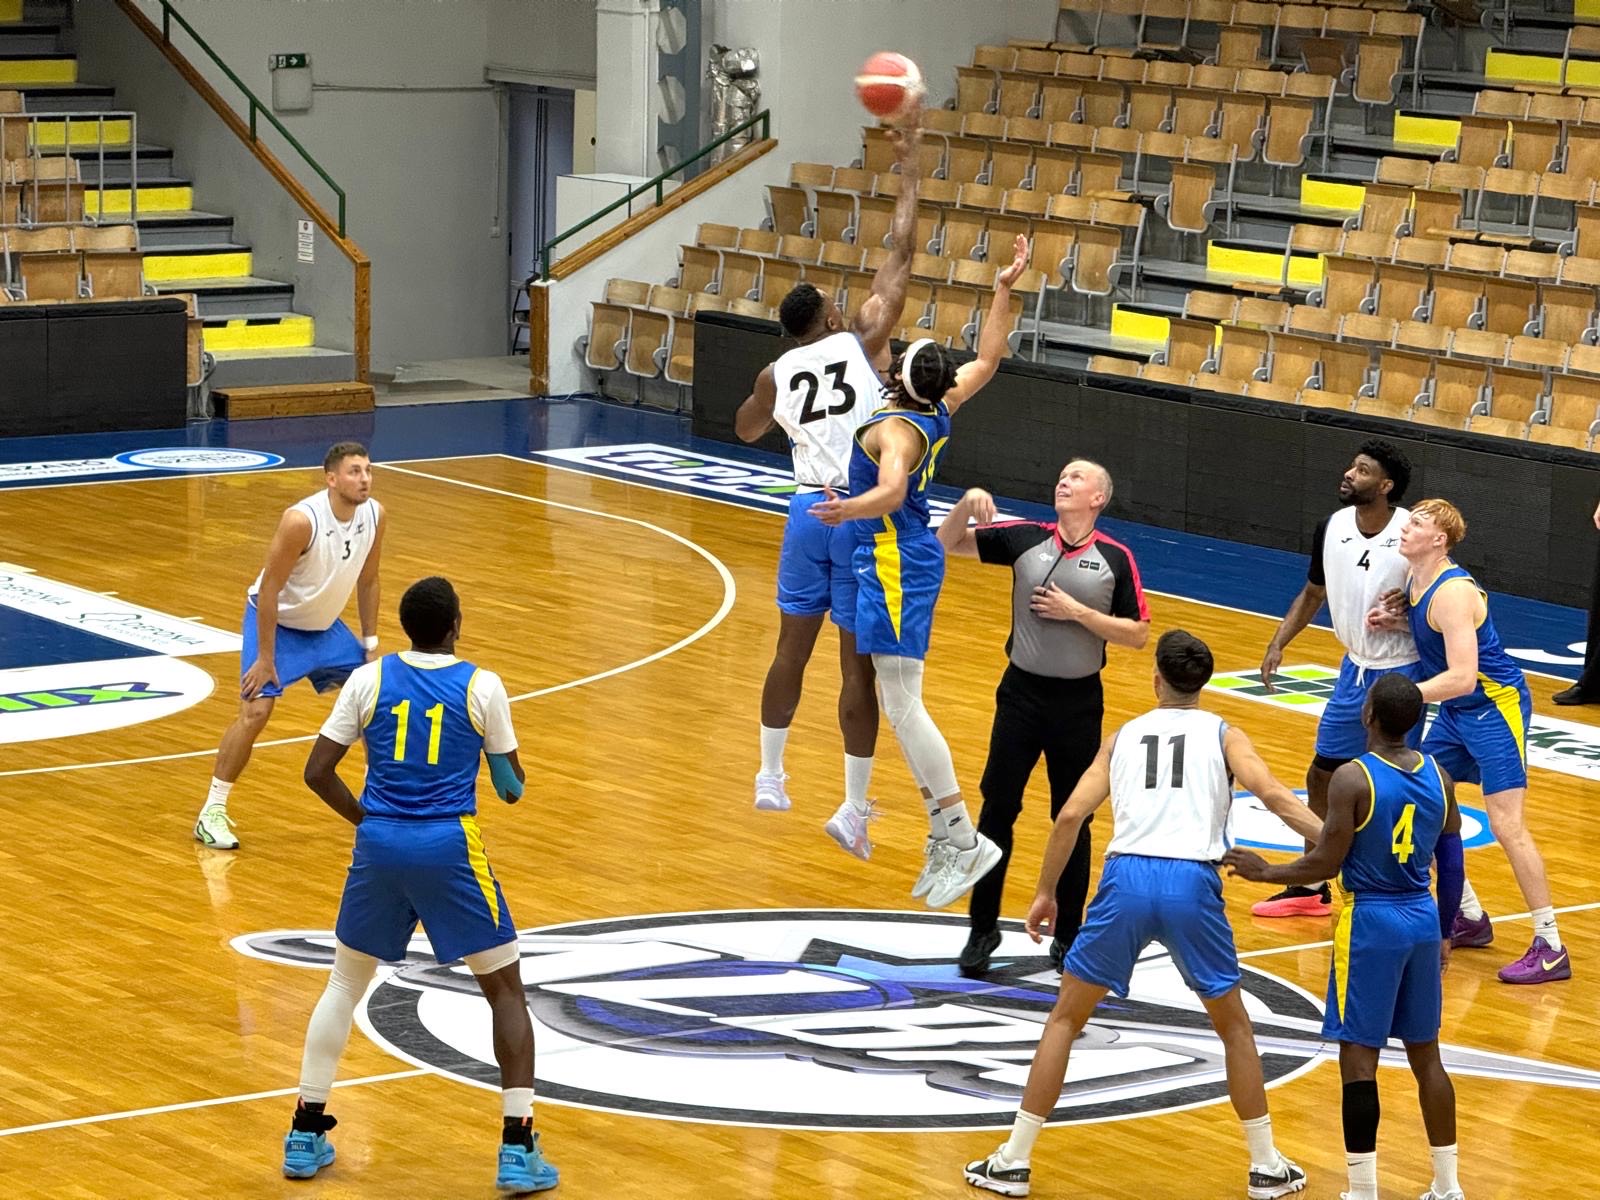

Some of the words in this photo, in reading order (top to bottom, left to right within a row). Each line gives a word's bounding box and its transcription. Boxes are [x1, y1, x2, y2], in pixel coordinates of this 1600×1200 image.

[788, 360, 857, 425] 23
[587, 450, 798, 499] TiPP
[342, 540, 351, 560] 3
[1356, 550, 1370, 571] 4
[391, 699, 444, 765] 11
[1139, 734, 1186, 789] 11
[1391, 803, 1416, 863] 4
